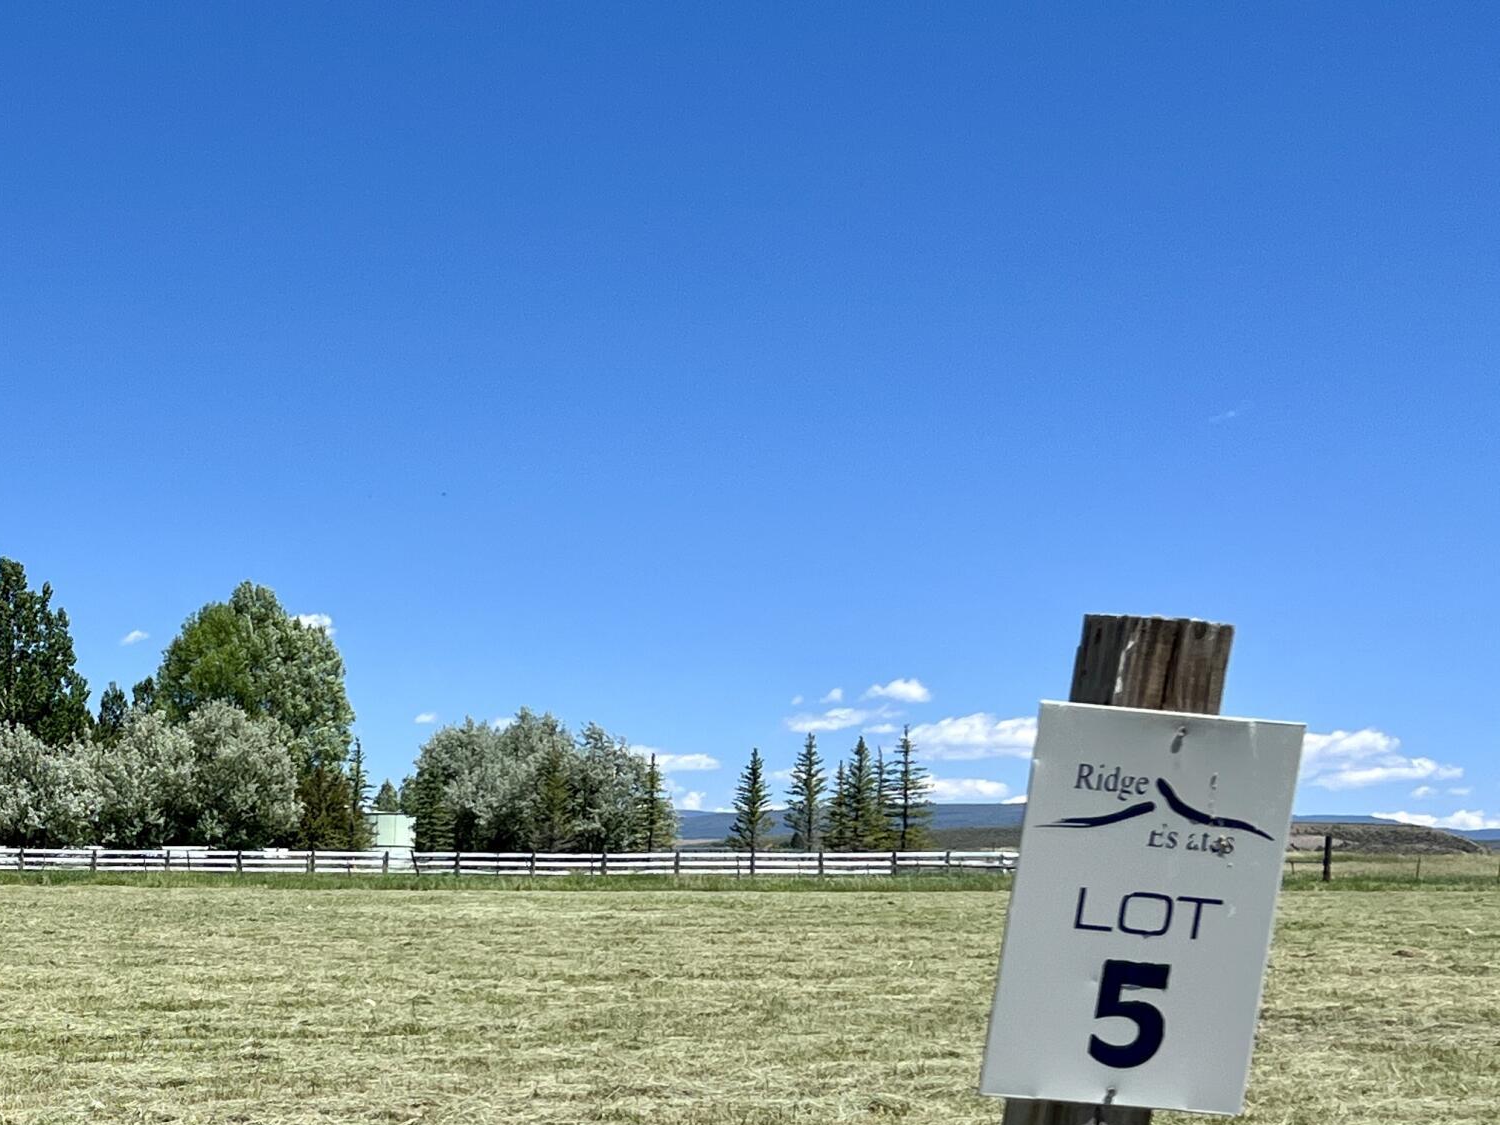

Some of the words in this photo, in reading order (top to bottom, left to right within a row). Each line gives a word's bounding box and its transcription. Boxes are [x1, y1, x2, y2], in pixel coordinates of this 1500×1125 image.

[1074, 763, 1150, 801] Ridge
[1073, 887, 1223, 940] LOT
[1087, 959, 1171, 1069] 5
